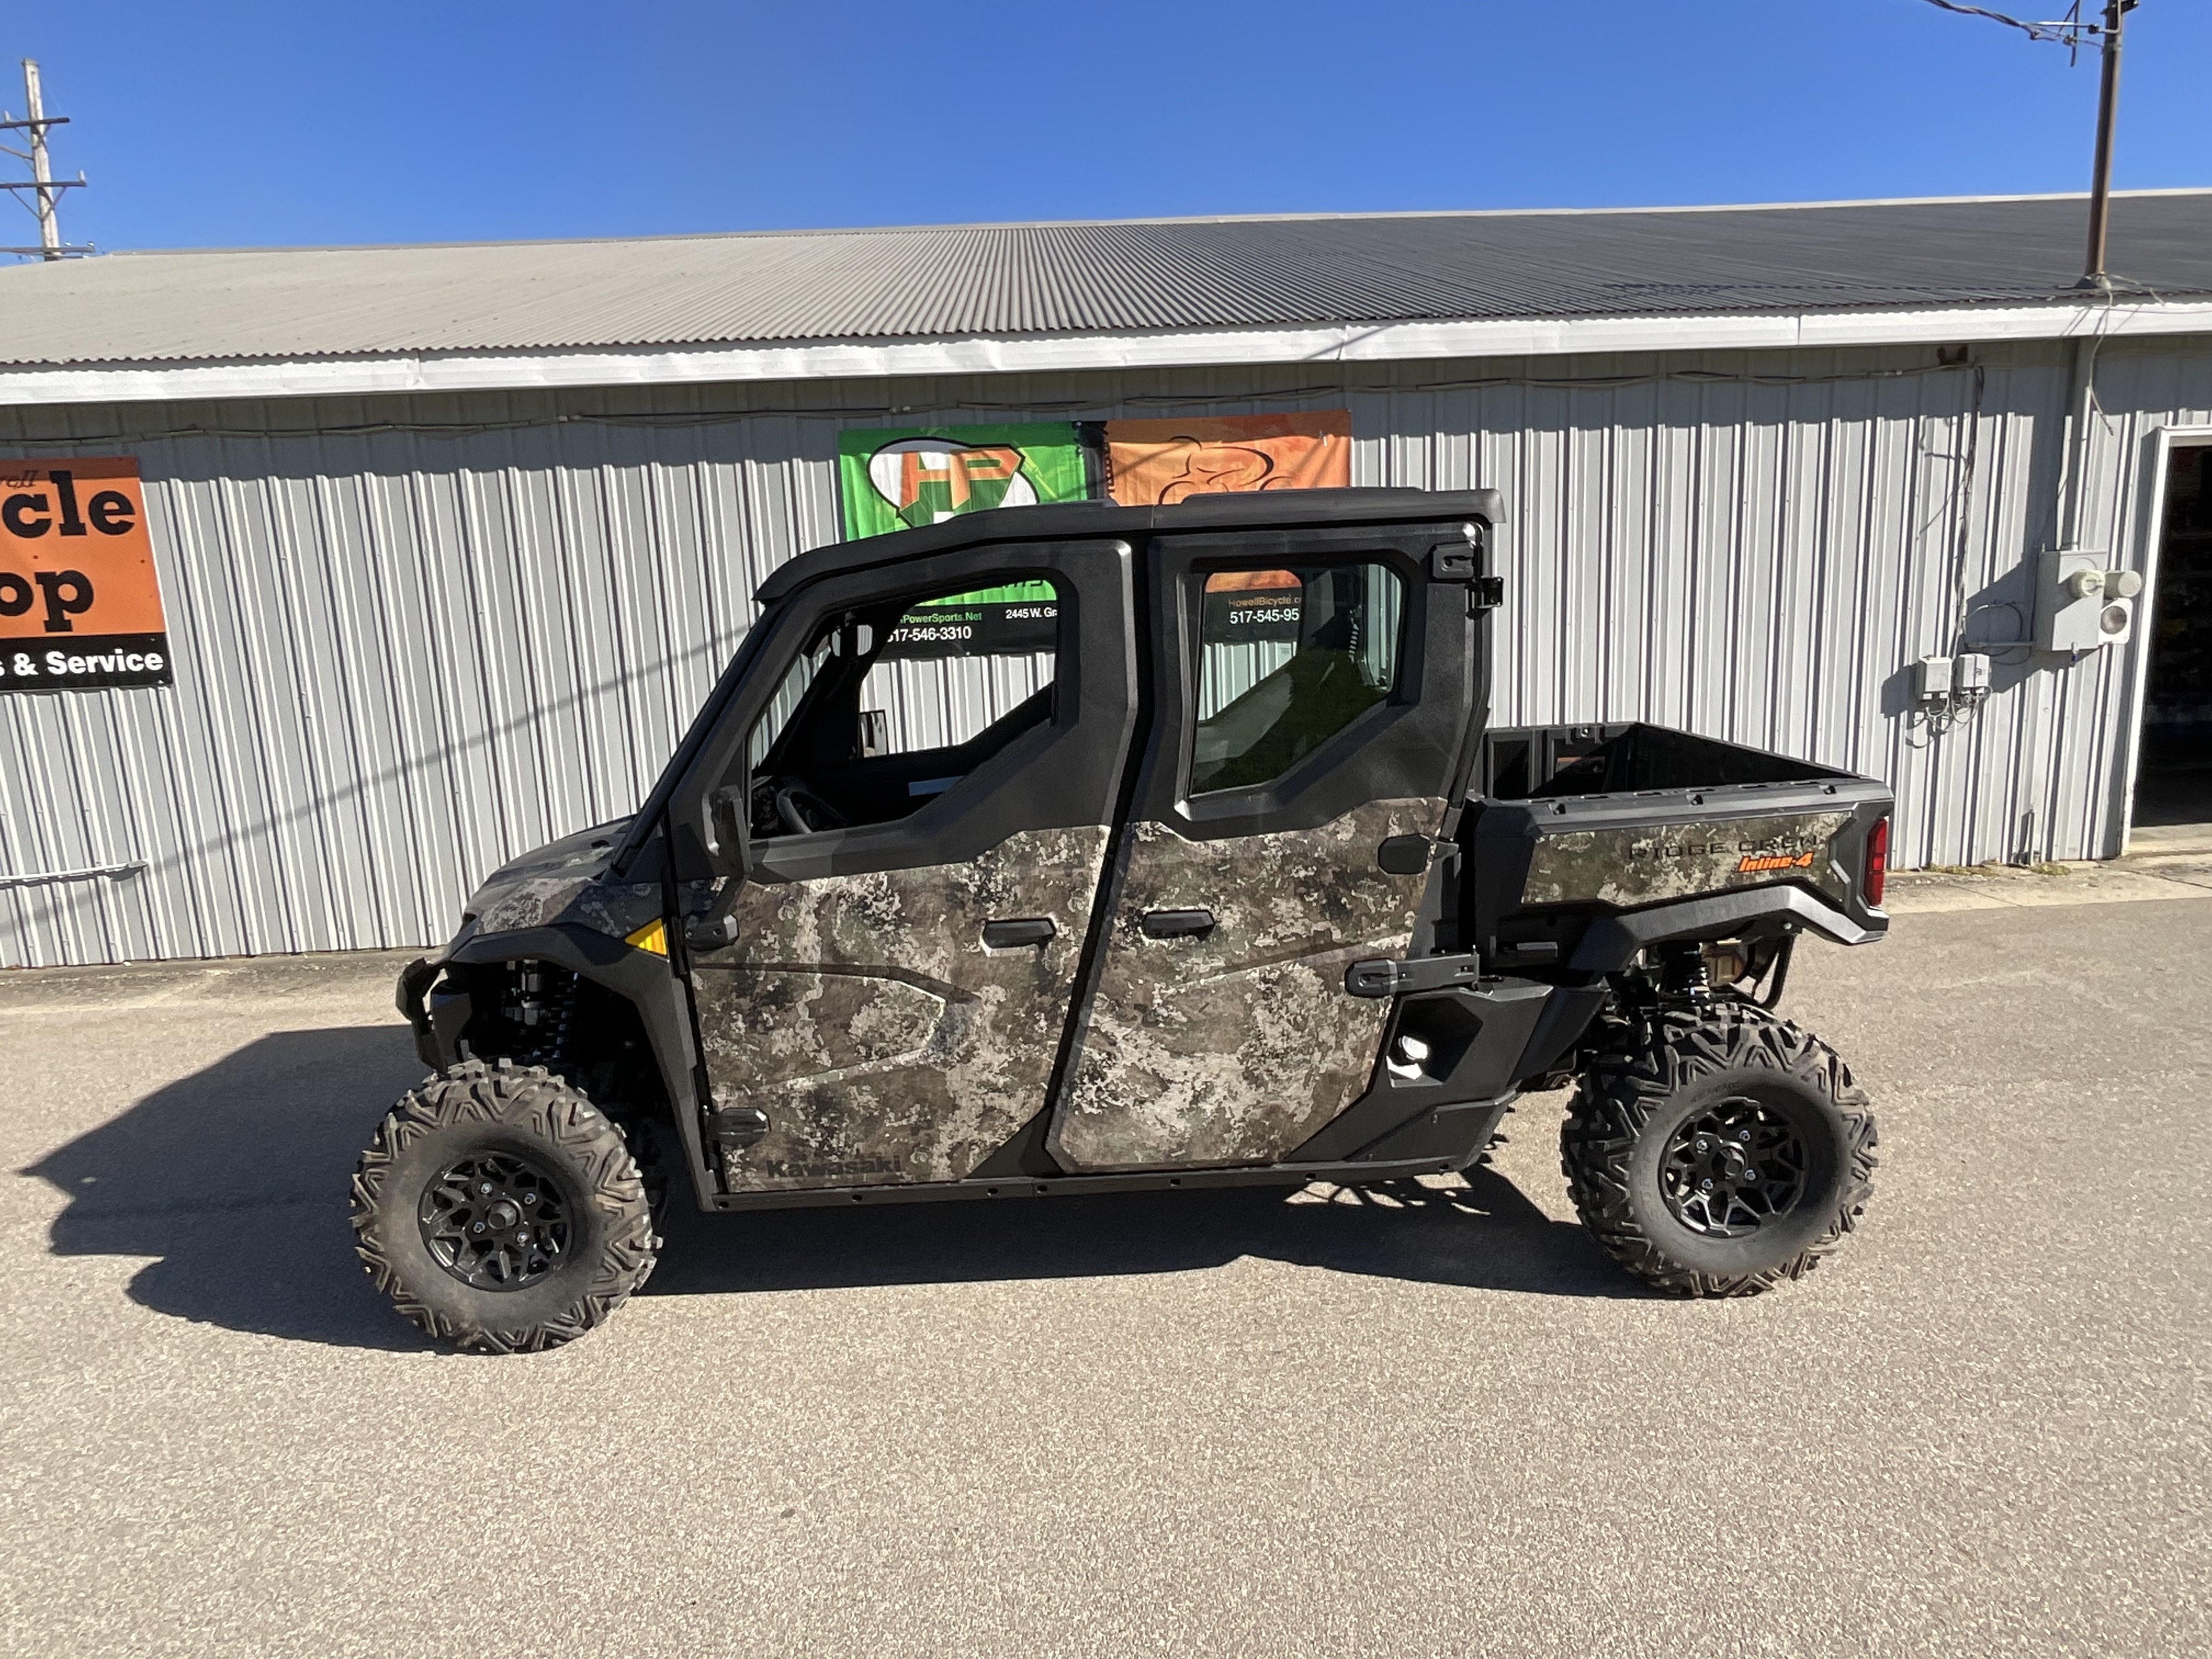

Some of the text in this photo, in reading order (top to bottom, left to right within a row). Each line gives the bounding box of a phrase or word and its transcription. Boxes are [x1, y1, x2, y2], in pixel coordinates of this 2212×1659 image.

[2, 470, 136, 539] cle
[0, 570, 94, 633] op
[1006, 608, 1029, 619] 2445
[1043, 607, 1058, 617] Gr
[1229, 608, 1300, 624] 517-545-95
[14, 653, 38, 676] &
[46, 648, 163, 675] Service
[1737, 851, 1814, 872] Inline-4
[766, 1154, 901, 1177] Kawasaki
